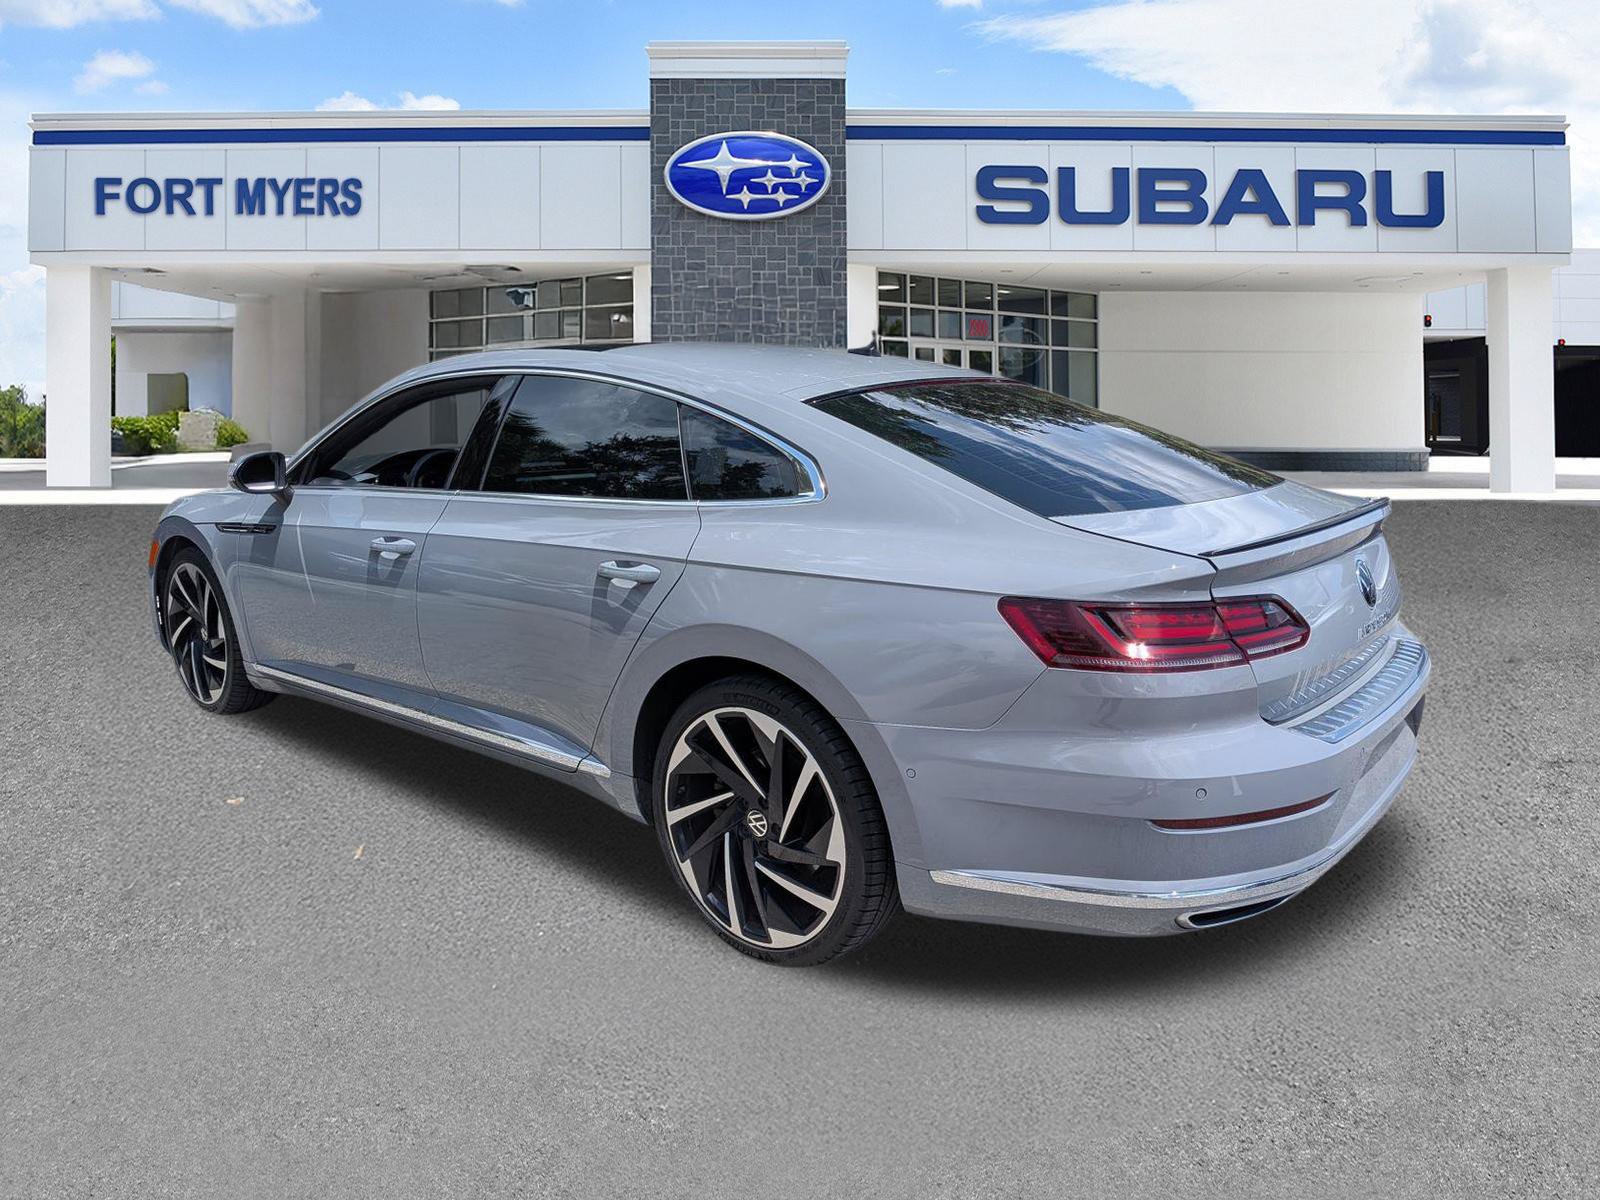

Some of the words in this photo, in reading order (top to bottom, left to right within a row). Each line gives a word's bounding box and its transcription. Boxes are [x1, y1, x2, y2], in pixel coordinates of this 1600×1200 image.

[94, 177, 223, 217] FORT
[235, 177, 363, 217] MYERS
[975, 165, 1446, 228] SUBARU
